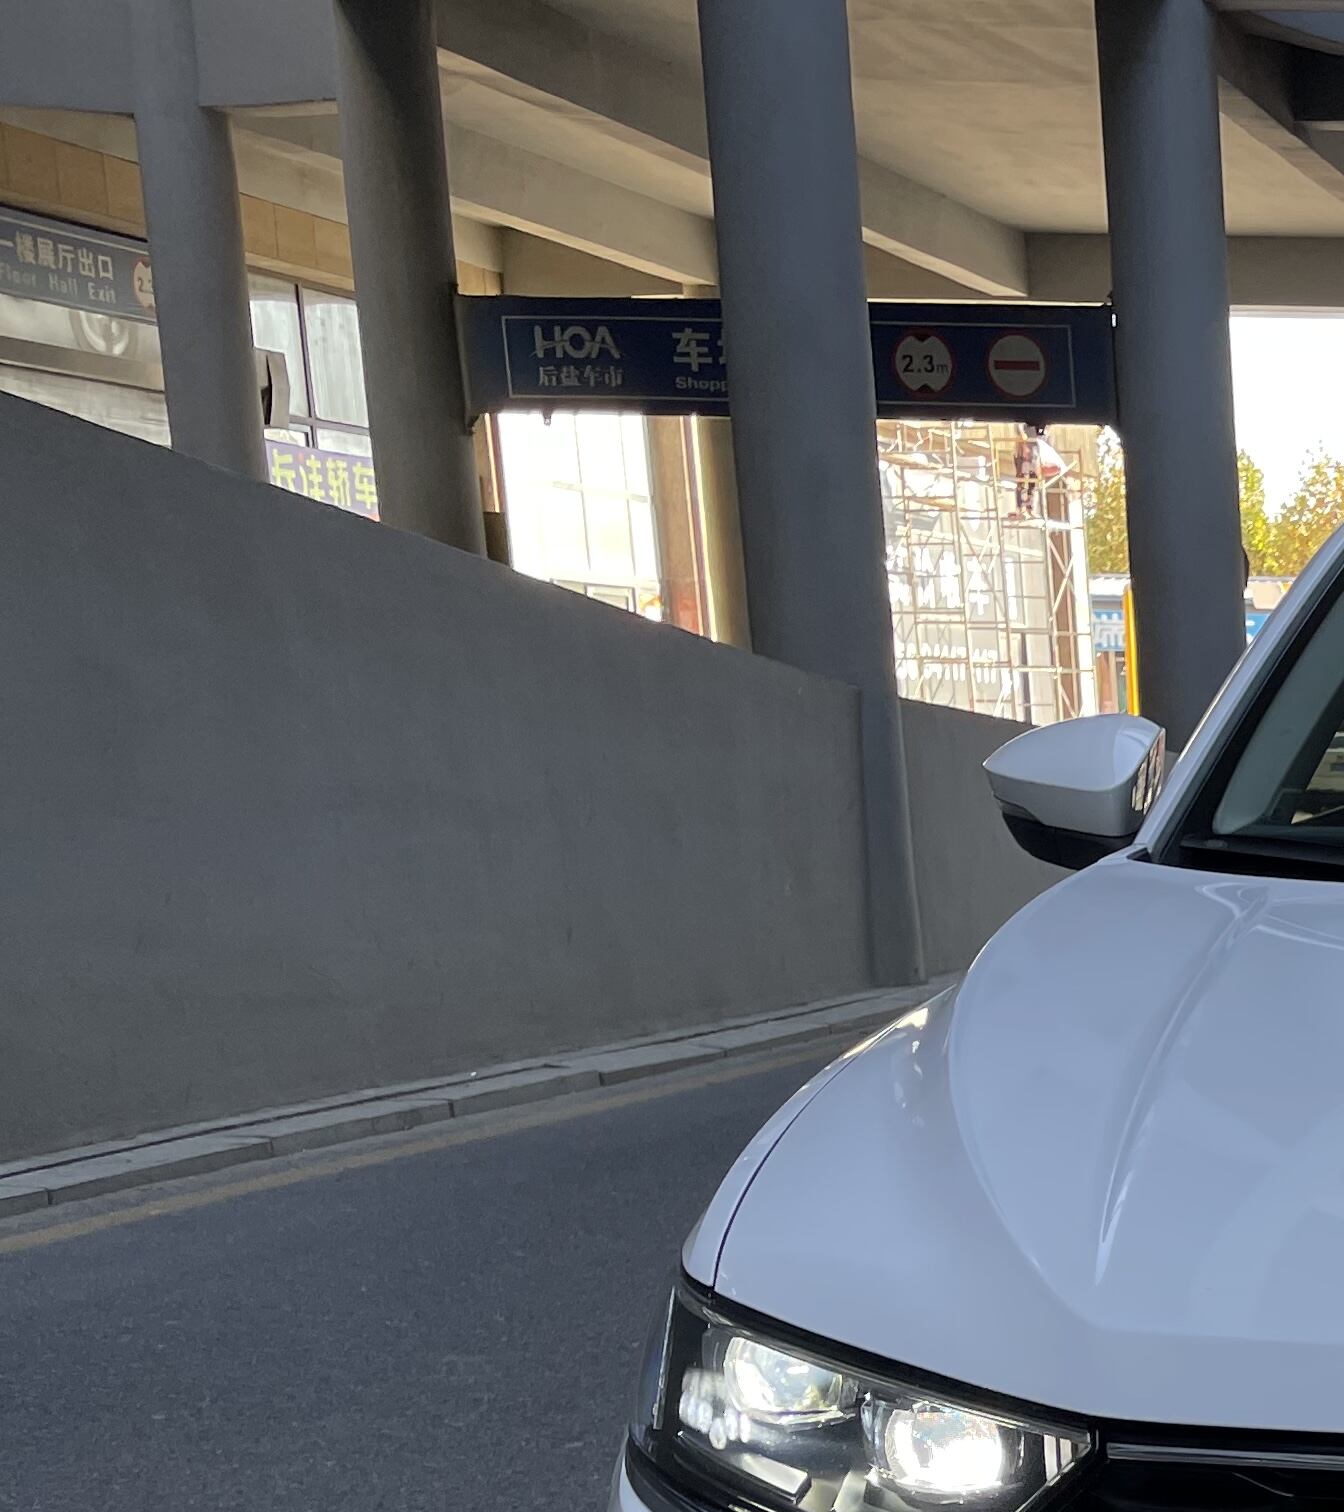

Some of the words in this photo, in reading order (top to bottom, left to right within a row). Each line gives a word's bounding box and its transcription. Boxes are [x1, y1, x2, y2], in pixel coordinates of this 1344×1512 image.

[48, 272, 79, 296] Hall
[87, 282, 117, 305] Exit
[530, 325, 622, 359] HOA
[671, 328, 727, 372] 车
[901, 354, 949, 374] 2.3m
